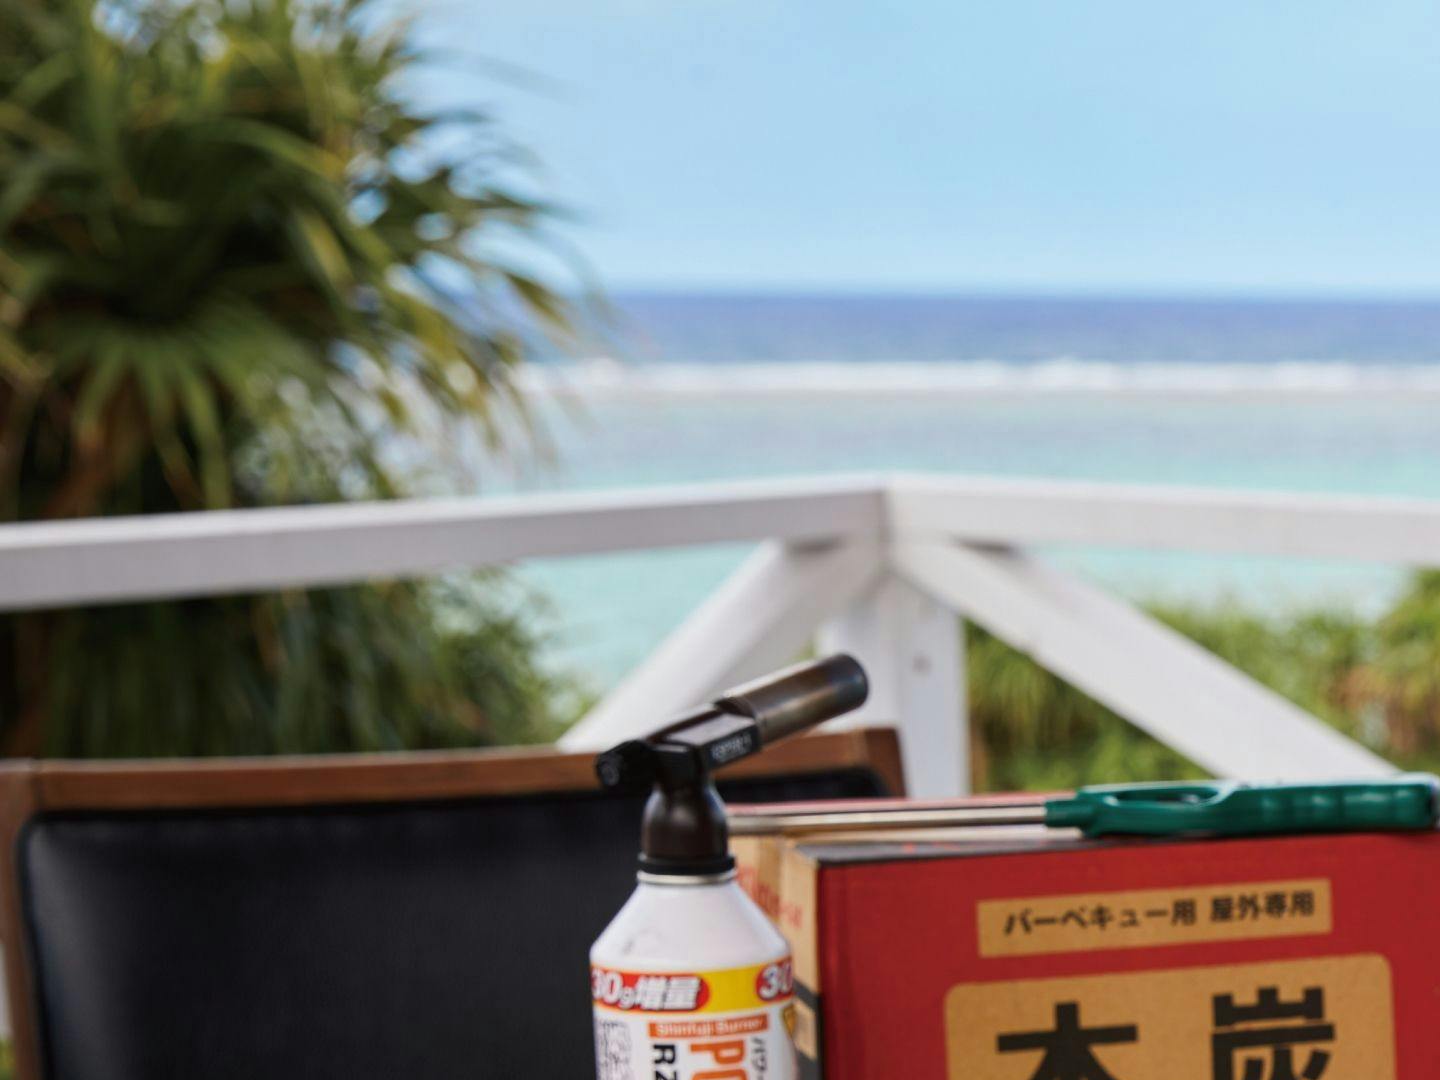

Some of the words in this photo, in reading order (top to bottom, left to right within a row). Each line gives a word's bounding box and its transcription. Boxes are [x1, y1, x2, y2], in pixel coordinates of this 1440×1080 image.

[1004, 900, 1197, 935] バーベキュー用
[1210, 890, 1315, 923] 屋外専用
